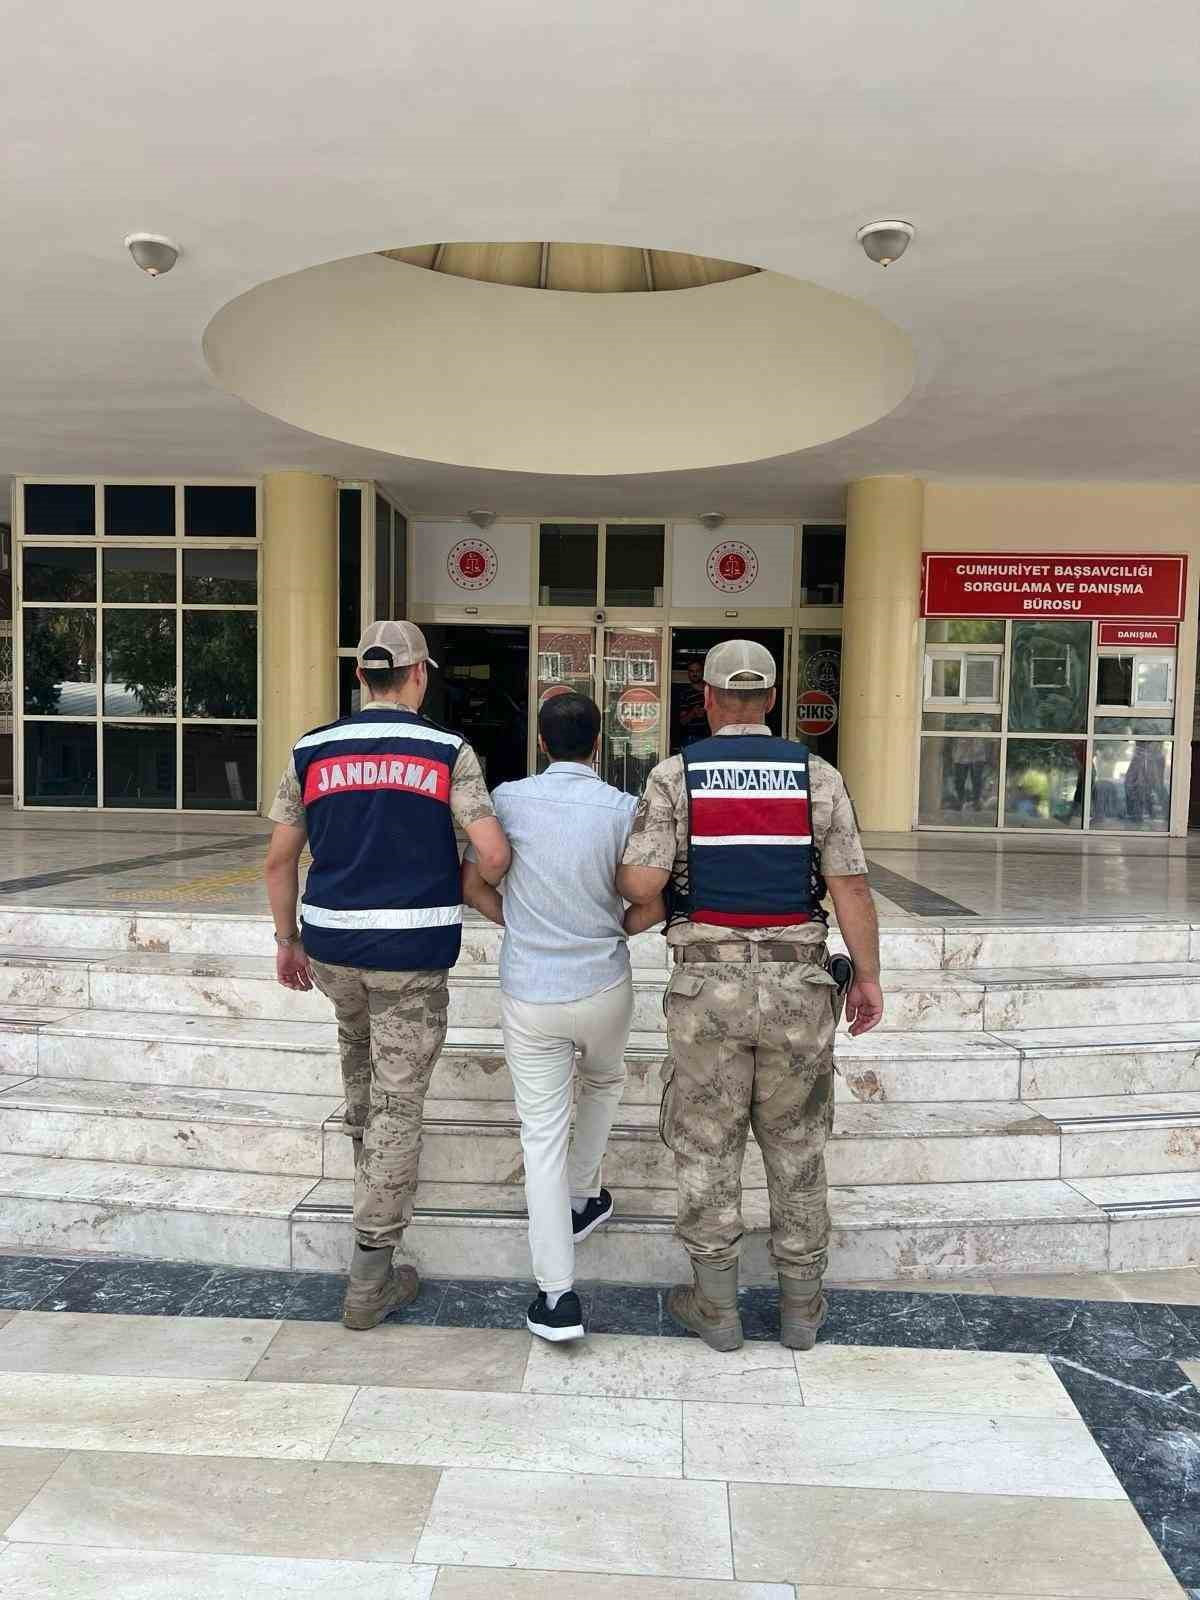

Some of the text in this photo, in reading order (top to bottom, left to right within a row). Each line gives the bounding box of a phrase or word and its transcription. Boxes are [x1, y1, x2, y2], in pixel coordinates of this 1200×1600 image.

[956, 563, 1153, 579] CUMHURİYET BAŞSAVCILIĞI
[963, 581, 1144, 596] SORGULAMA VE DANIŞMA
[1023, 597, 1082, 610] BÜROSU
[1117, 631, 1158, 640] DANIŞMA
[318, 760, 439, 794] JANDARMA
[700, 768, 799, 790] JANDARMA
